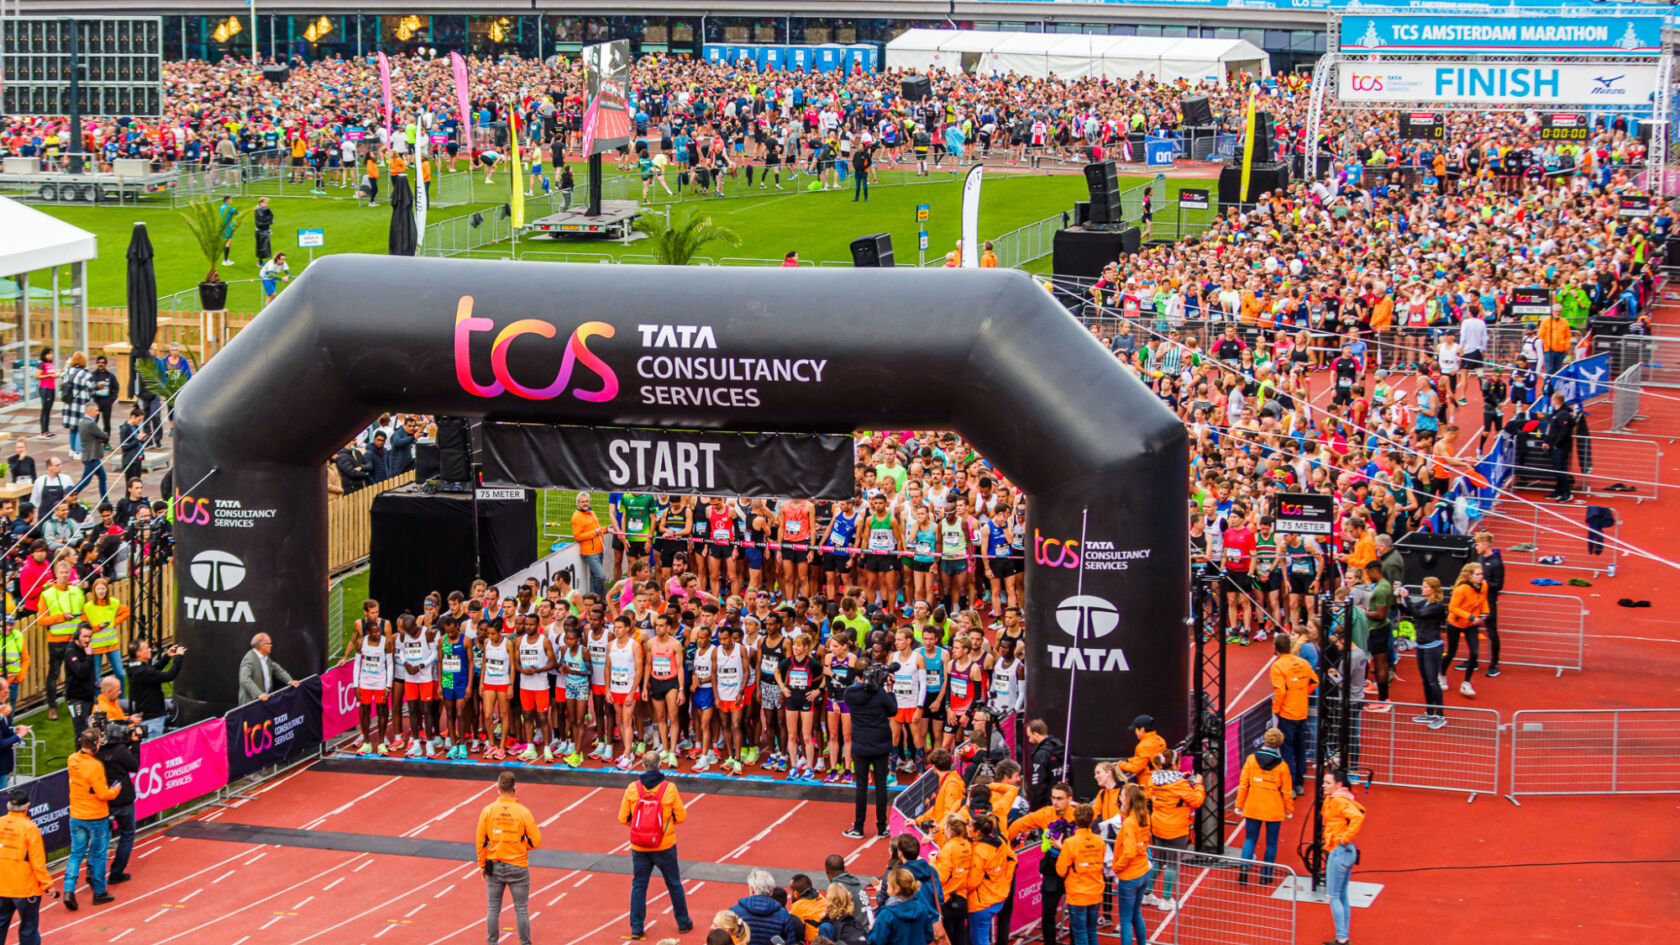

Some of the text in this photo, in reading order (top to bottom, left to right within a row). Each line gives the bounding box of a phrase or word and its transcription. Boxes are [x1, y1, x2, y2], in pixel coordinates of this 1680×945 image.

[1392, 25, 1608, 41] TCS AMSTERDAM MARATHON
[1352, 71, 1384, 91] tcs
[1435, 68, 1559, 98] FINISH
[1542, 128, 1587, 139] 0:00:00
[637, 324, 718, 349] TATA
[453, 294, 619, 403] tcs
[636, 355, 828, 383] CONSULTANCY
[639, 385, 761, 408] SERVICES
[608, 439, 721, 489] START
[480, 490, 520, 498] 75 METER
[175, 487, 210, 526] tcs
[214, 499, 241, 508] TATA
[1281, 501, 1303, 516] tcs
[214, 509, 277, 518] CONSULTANCY
[214, 518, 254, 528] SERVICES
[1281, 521, 1326, 531] 75 METER
[1034, 527, 1080, 569] tcs
[1085, 541, 1115, 550] TATA
[1085, 549, 1151, 561] CONSULTANCY
[1085, 561, 1128, 570] SERVICES
[183, 596, 257, 623] TATA
[1047, 644, 1130, 672] TATA
[337, 680, 361, 716] tc
[273, 712, 288, 725] TATA
[274, 714, 305, 736] CONSULTANCY
[243, 719, 273, 757] tcs
[274, 729, 295, 746] SERVICES
[163, 757, 203, 779] CONSULTANCY
[165, 756, 184, 768] TATA
[130, 762, 163, 801] cs
[165, 774, 193, 790] SERVICES
[29, 802, 50, 817] TATA
